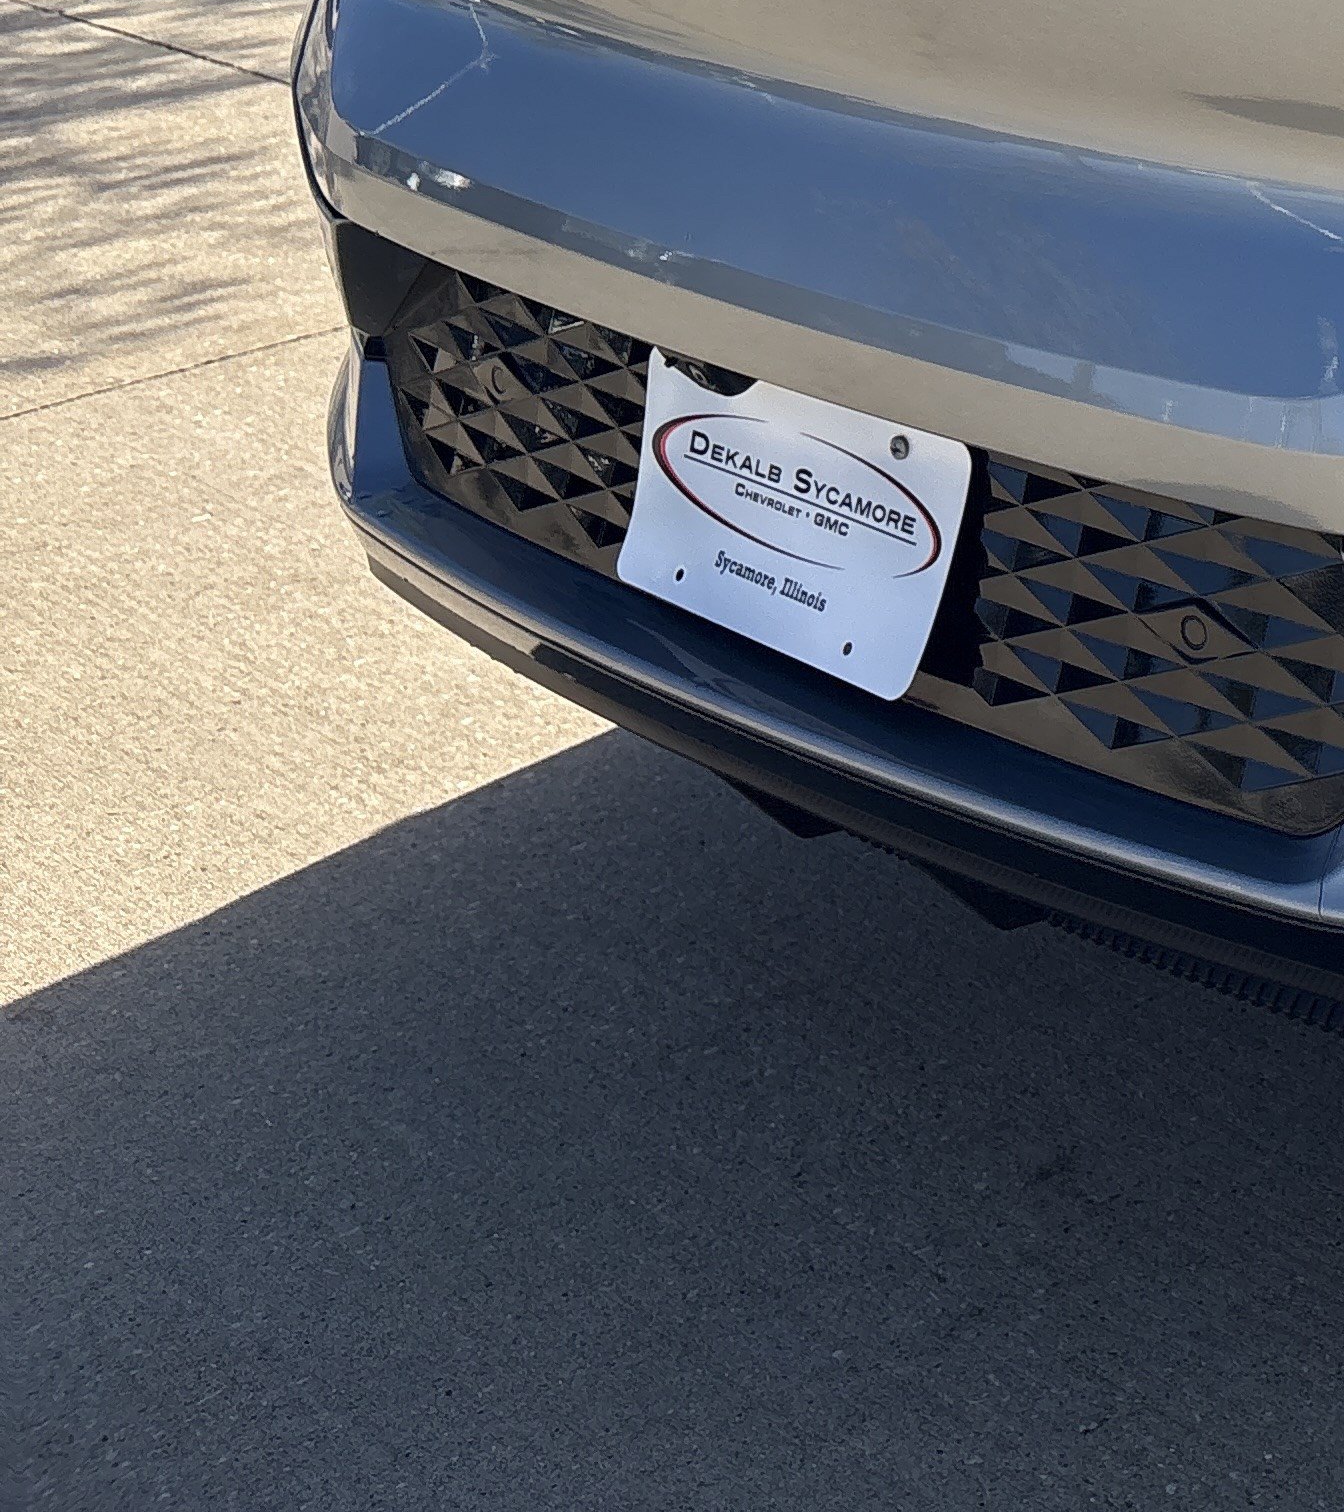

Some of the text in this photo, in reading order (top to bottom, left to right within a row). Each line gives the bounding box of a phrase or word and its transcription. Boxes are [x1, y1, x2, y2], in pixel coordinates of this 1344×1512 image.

[735, 482, 850, 537] CHEVROLET GMC
[793, 468, 917, 536] SYCAMORE
[714, 549, 827, 613] Sycamore, Illinois
